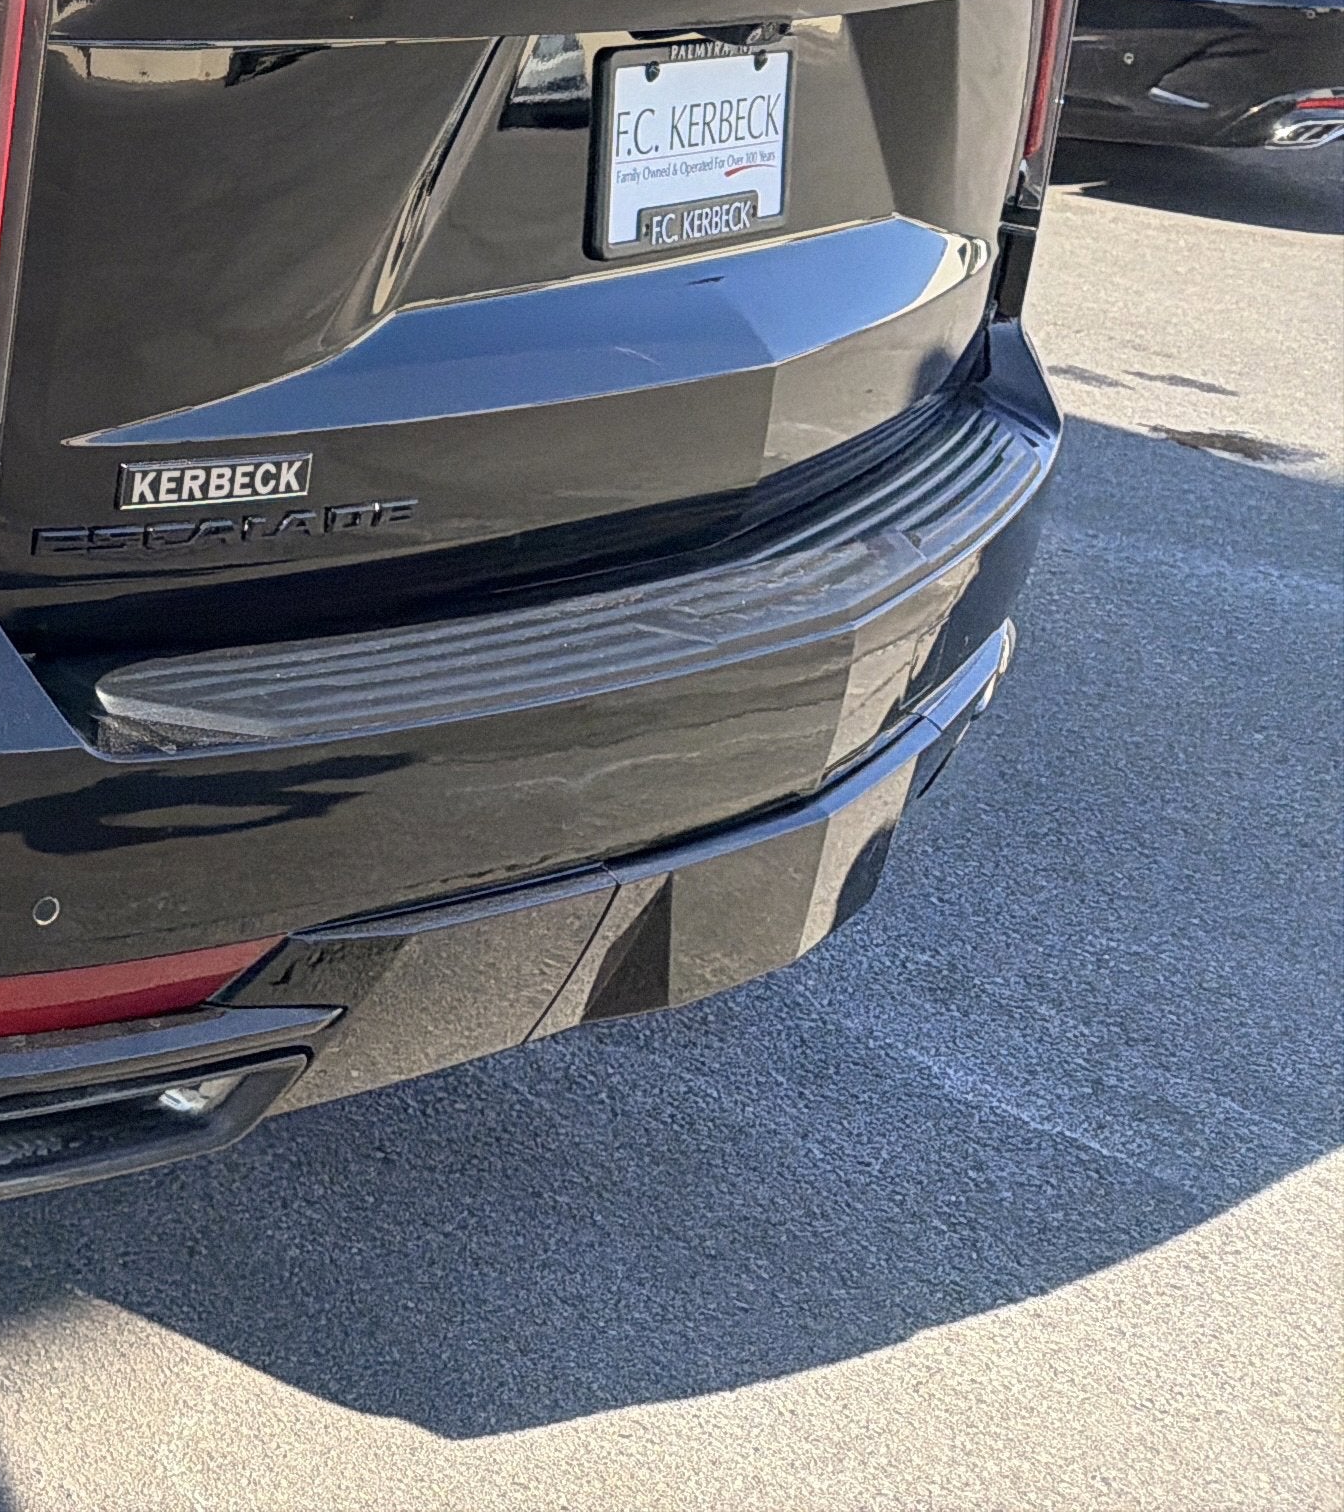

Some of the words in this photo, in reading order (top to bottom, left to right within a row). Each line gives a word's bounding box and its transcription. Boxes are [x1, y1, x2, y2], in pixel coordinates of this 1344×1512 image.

[615, 108, 660, 157] F.C.
[669, 93, 782, 151] KERBECK
[616, 166, 642, 184] Family
[642, 163, 671, 179] Owned
[679, 157, 713, 177] Operated
[714, 156, 725, 169] For
[727, 154, 744, 167] Over
[759, 150, 776, 163] Years
[683, 200, 752, 239] KERBECK
[131, 460, 304, 504] KERBECK
